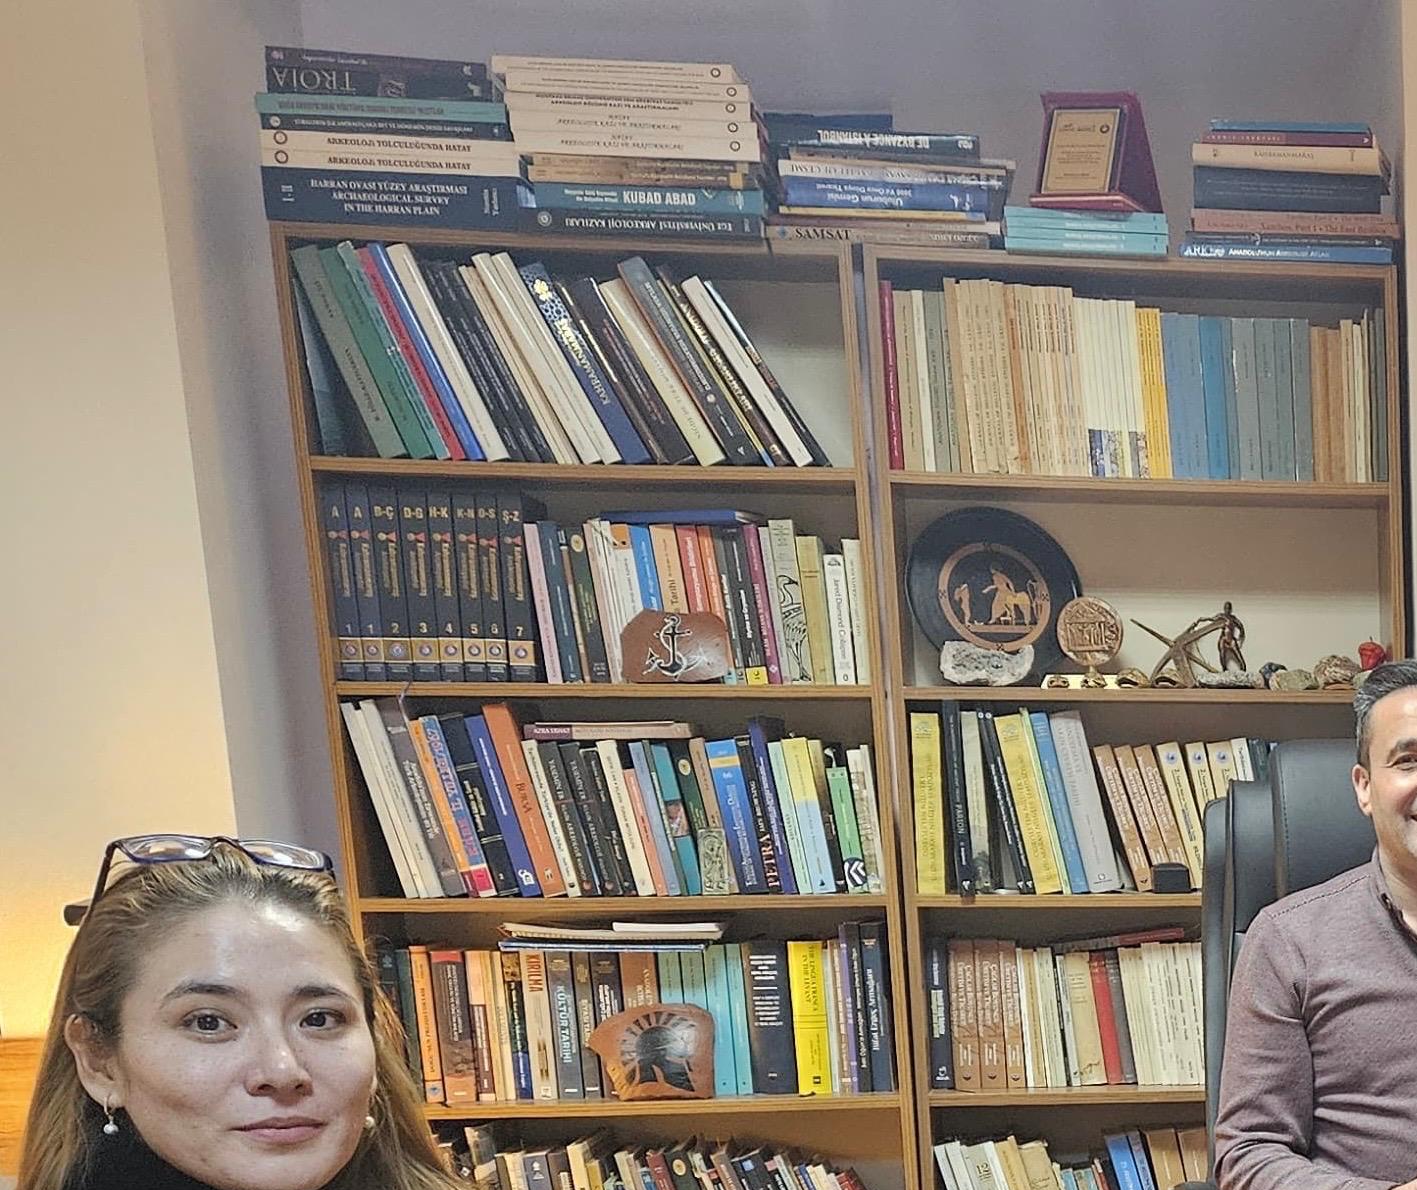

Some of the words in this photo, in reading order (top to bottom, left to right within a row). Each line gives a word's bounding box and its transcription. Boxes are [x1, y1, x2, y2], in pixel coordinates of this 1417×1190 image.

[623, 190, 662, 205] KUBAD
[664, 192, 696, 206] ABAD
[355, 204, 374, 213] THE
[795, 228, 851, 241] SAMSAT
[331, 505, 340, 518] A
[353, 506, 362, 519] A
[345, 623, 351, 634] 1
[368, 623, 374, 634] 1
[391, 623, 399, 634] 2
[419, 623, 428, 634] 3
[445, 623, 453, 634] 4
[470, 623, 478, 635] 5
[491, 623, 498, 634] 6
[516, 626, 524, 637] 7
[758, 833, 780, 888] PETRA
[525, 953, 545, 993] KIRILMA
[556, 985, 569, 1026] KÜLTÜR
[560, 1026, 573, 1064] TARİHİ
